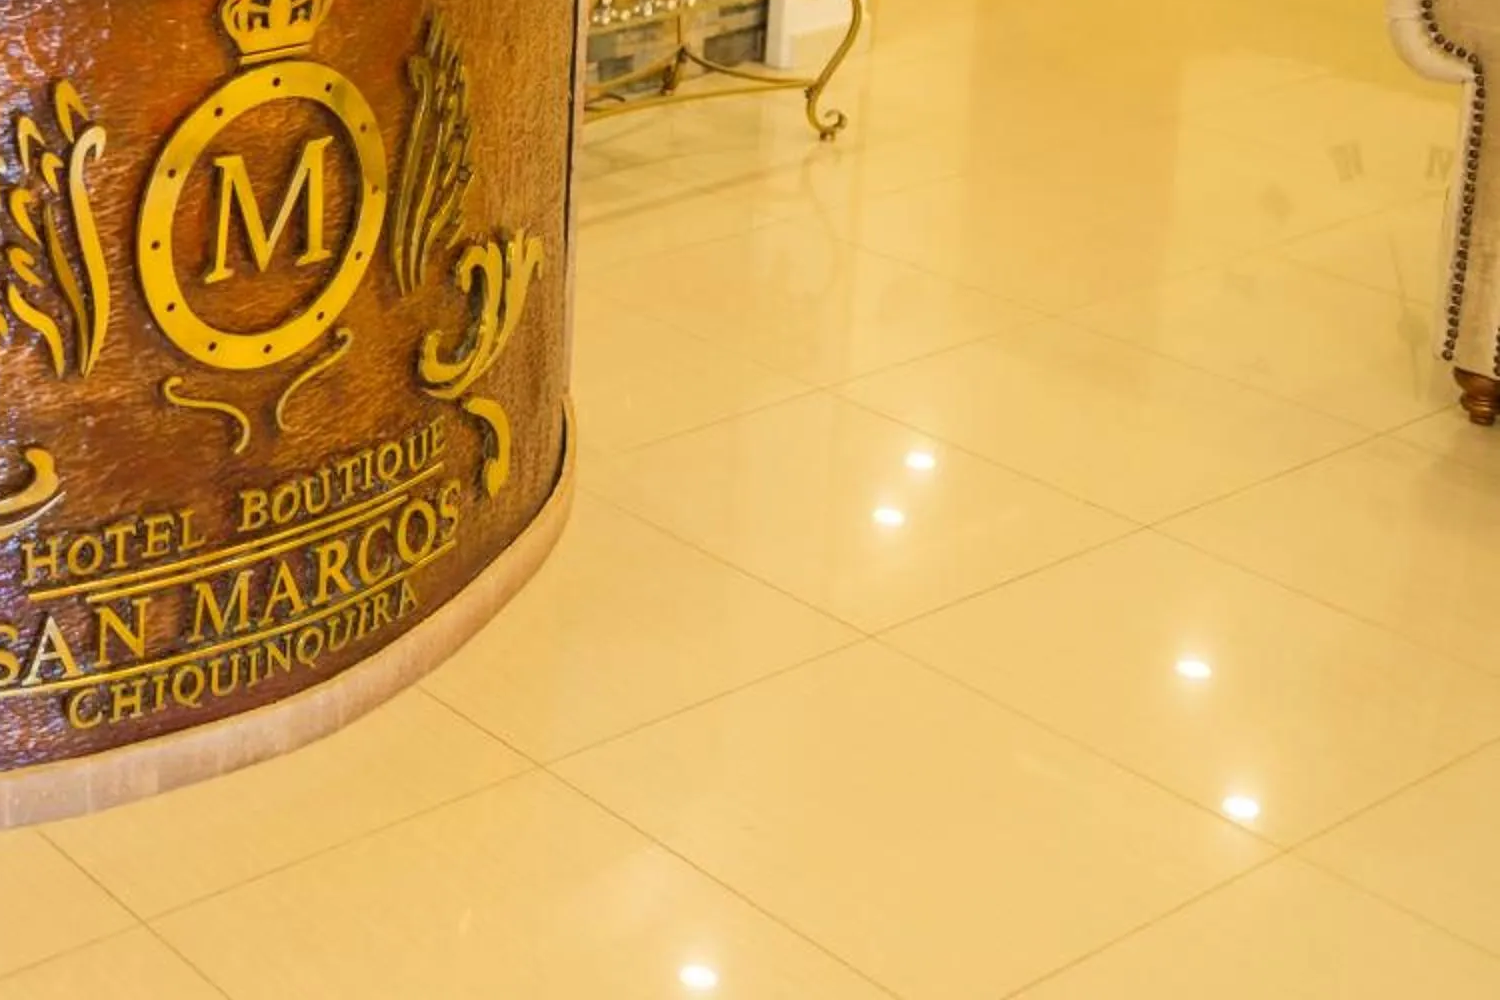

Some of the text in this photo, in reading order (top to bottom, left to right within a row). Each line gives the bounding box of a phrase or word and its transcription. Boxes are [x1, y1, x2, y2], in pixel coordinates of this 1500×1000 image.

[204, 135, 334, 283] M
[21, 415, 446, 586] HOTEL BOUTIQUE
[187, 481, 462, 643] MARCOS
[69, 581, 418, 729] CHIQUINQUIRA
